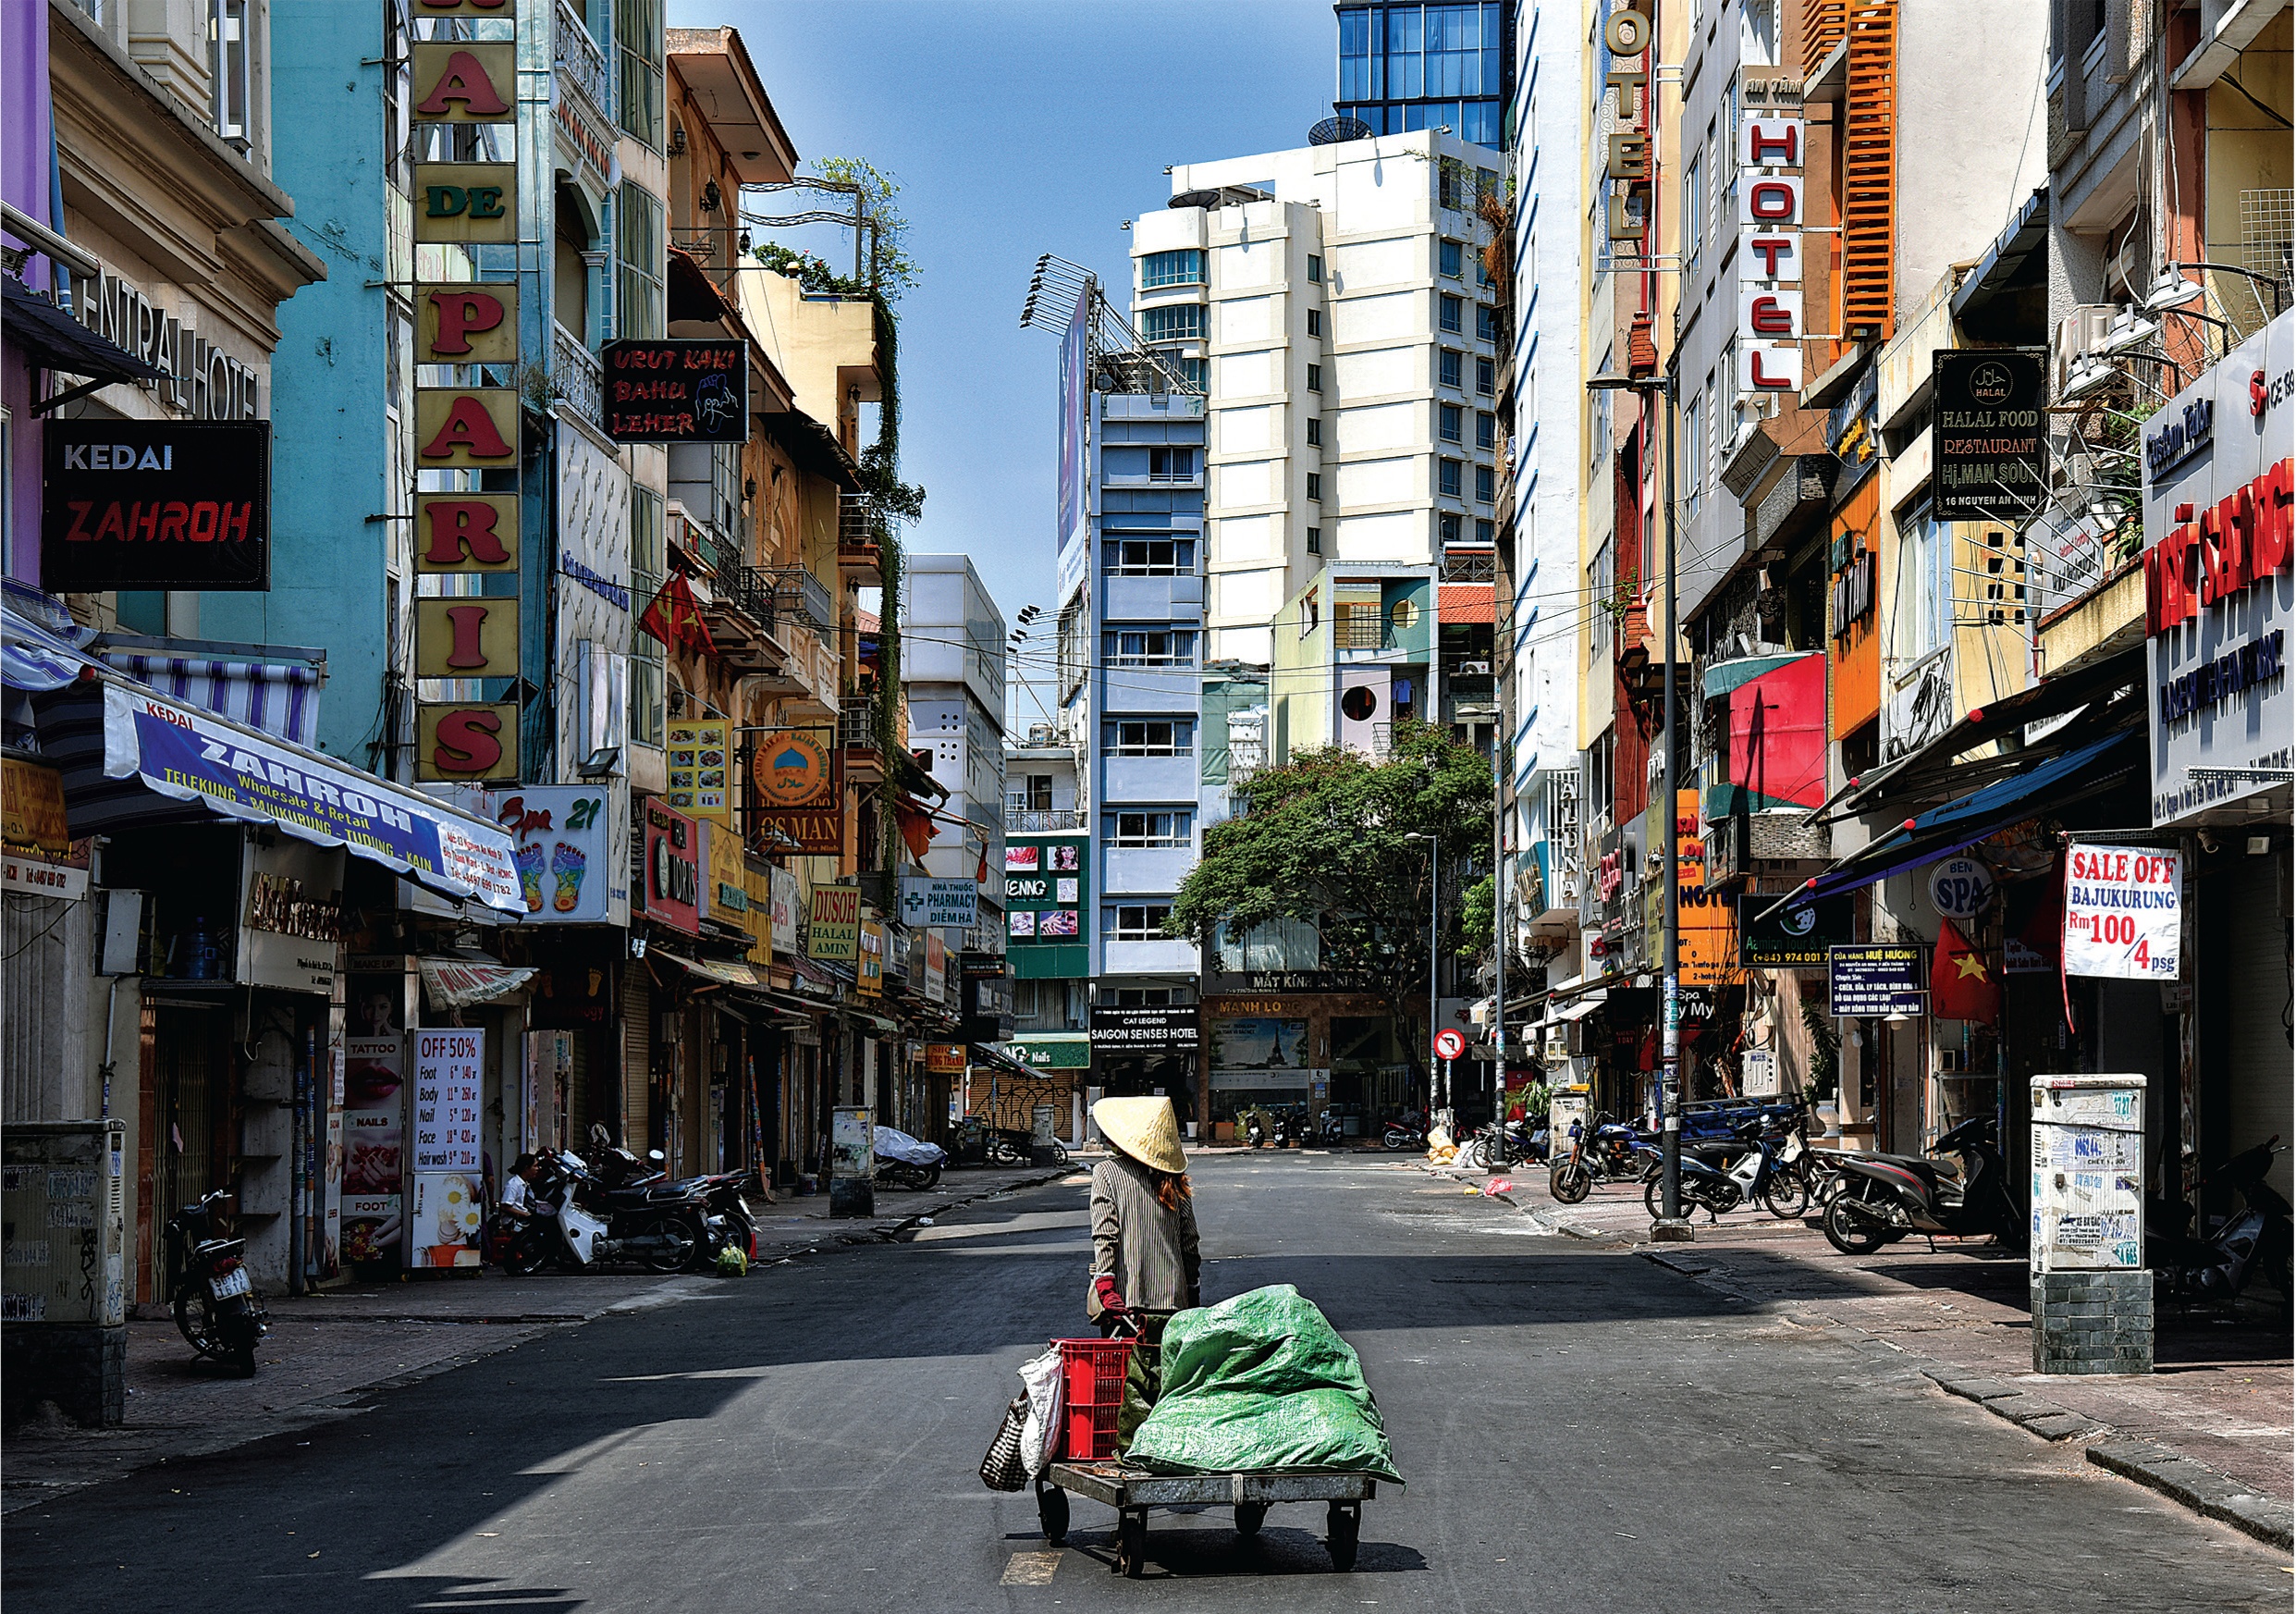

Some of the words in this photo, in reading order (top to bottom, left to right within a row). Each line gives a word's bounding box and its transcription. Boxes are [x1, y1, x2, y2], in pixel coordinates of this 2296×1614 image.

[1745, 79, 1767, 93] AN
[426, 186, 505, 218] DE
[1750, 124, 1795, 387] HOTEL
[54, 266, 188, 412] ENTRAL
[614, 350, 677, 369] URUT
[684, 350, 736, 370] KAKI
[1975, 388, 2007, 397] HALAL
[612, 413, 694, 435] LEHER
[1942, 411, 1996, 428] HALAL
[1998, 410, 2039, 427] FOOD
[2146, 422, 2183, 470] Custom
[2182, 397, 2214, 443] Tailor
[1944, 438, 2037, 454] RESTAURANT
[65, 445, 172, 470] KEDAI
[1946, 498, 1957, 506] 16
[1958, 496, 1996, 506] NGUYEN
[1998, 496, 2011, 505] AN
[65, 500, 252, 542] ZAHROH
[419, 291, 514, 773] PARIS
[146, 702, 194, 731] KEDAI
[200, 736, 412, 834] ZAHROH
[238, 773, 309, 810] Wholesale
[313, 801, 325, 815] &
[328, 806, 371, 831] Retail
[806, 797, 840, 812] OOD
[164, 767, 237, 803] TELEKUNG
[345, 827, 394, 858] TUDUNG
[406, 851, 432, 873] KAIN
[497, 795, 554, 842] Spa
[566, 798, 601, 830] 21
[819, 844, 839, 853] Ninh
[1560, 782, 1578, 899] ALUNA
[1950, 861, 1973, 874] BEN
[2073, 851, 2129, 882] SALE
[2134, 856, 2178, 884] OFF
[493, 883, 512, 895] 1782
[670, 855, 696, 907] IDRIS
[932, 881, 947, 892] NHÀ
[949, 881, 974, 892] THUỐC
[927, 893, 976, 908] PHARMACY
[1936, 876, 1988, 914] SPA
[2071, 886, 2176, 909] BAJUKURUNG
[814, 890, 858, 924] DUSOH
[958, 911, 973, 923] HÀ
[812, 927, 855, 941] HALAL
[815, 943, 850, 955] AMIN
[1786, 935, 1809, 951] Tour
[1810, 935, 1818, 951] &
[353, 959, 381, 969] MAKE
[383, 959, 396, 969] UP
[1752, 952, 1782, 963] (+84)
[1785, 952, 1803, 962] 974
[1803, 952, 1821, 962] 001
[1848, 952, 1864, 960] HÀNG
[2152, 956, 2176, 973] psg
[1283, 974, 1313, 988] KÍNH
[1690, 1002, 1714, 1019] My
[1091, 1029, 1129, 1040] SAIGON
[1130, 1029, 1169, 1040] SENSES
[1170, 1028, 1199, 1039] HOTEL
[350, 1043, 397, 1054] TATTOO
[421, 1037, 447, 1058] OFF
[449, 1036, 476, 1058] 50%
[1032, 1051, 1051, 1064] Nails
[419, 1065, 437, 1080] Foot
[449, 1066, 454, 1079] 6
[461, 1066, 472, 1080] 140
[419, 1086, 439, 1104] Body
[447, 1087, 454, 1101] 11
[461, 1087, 472, 1101] 260
[356, 1116, 389, 1127] NAILS
[418, 1107, 436, 1123] Nail
[449, 1108, 454, 1122] 5
[461, 1108, 472, 1122] 120
[418, 1129, 436, 1144] Face
[446, 1129, 453, 1144] 18
[460, 1129, 471, 1144] 420
[417, 1151, 431, 1165] Hair
[431, 1150, 448, 1165] wash
[448, 1151, 453, 1165] 9
[355, 1201, 387, 1212] FOOT
[217, 1282, 247, 1298] 1614
